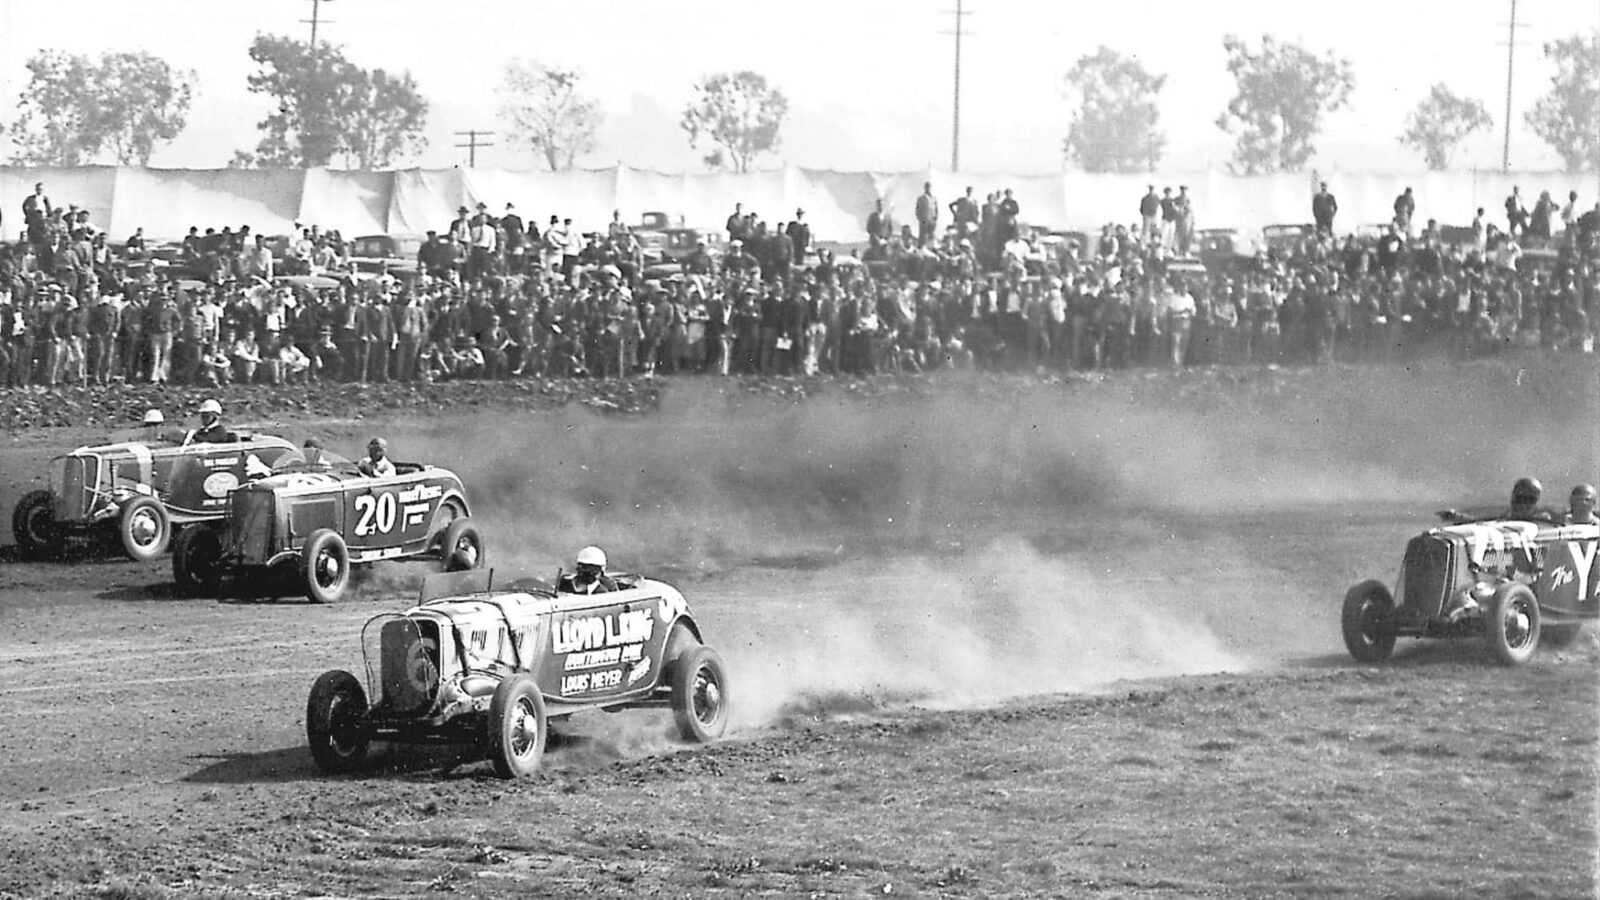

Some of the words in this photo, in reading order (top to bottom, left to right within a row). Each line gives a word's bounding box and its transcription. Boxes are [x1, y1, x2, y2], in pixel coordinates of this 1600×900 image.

[355, 492, 396, 536] 20
[1551, 565, 1574, 591] The
[552, 616, 605, 653] LLOYD
[562, 674, 590, 695] LOUIS
[590, 669, 622, 688] MEYER
